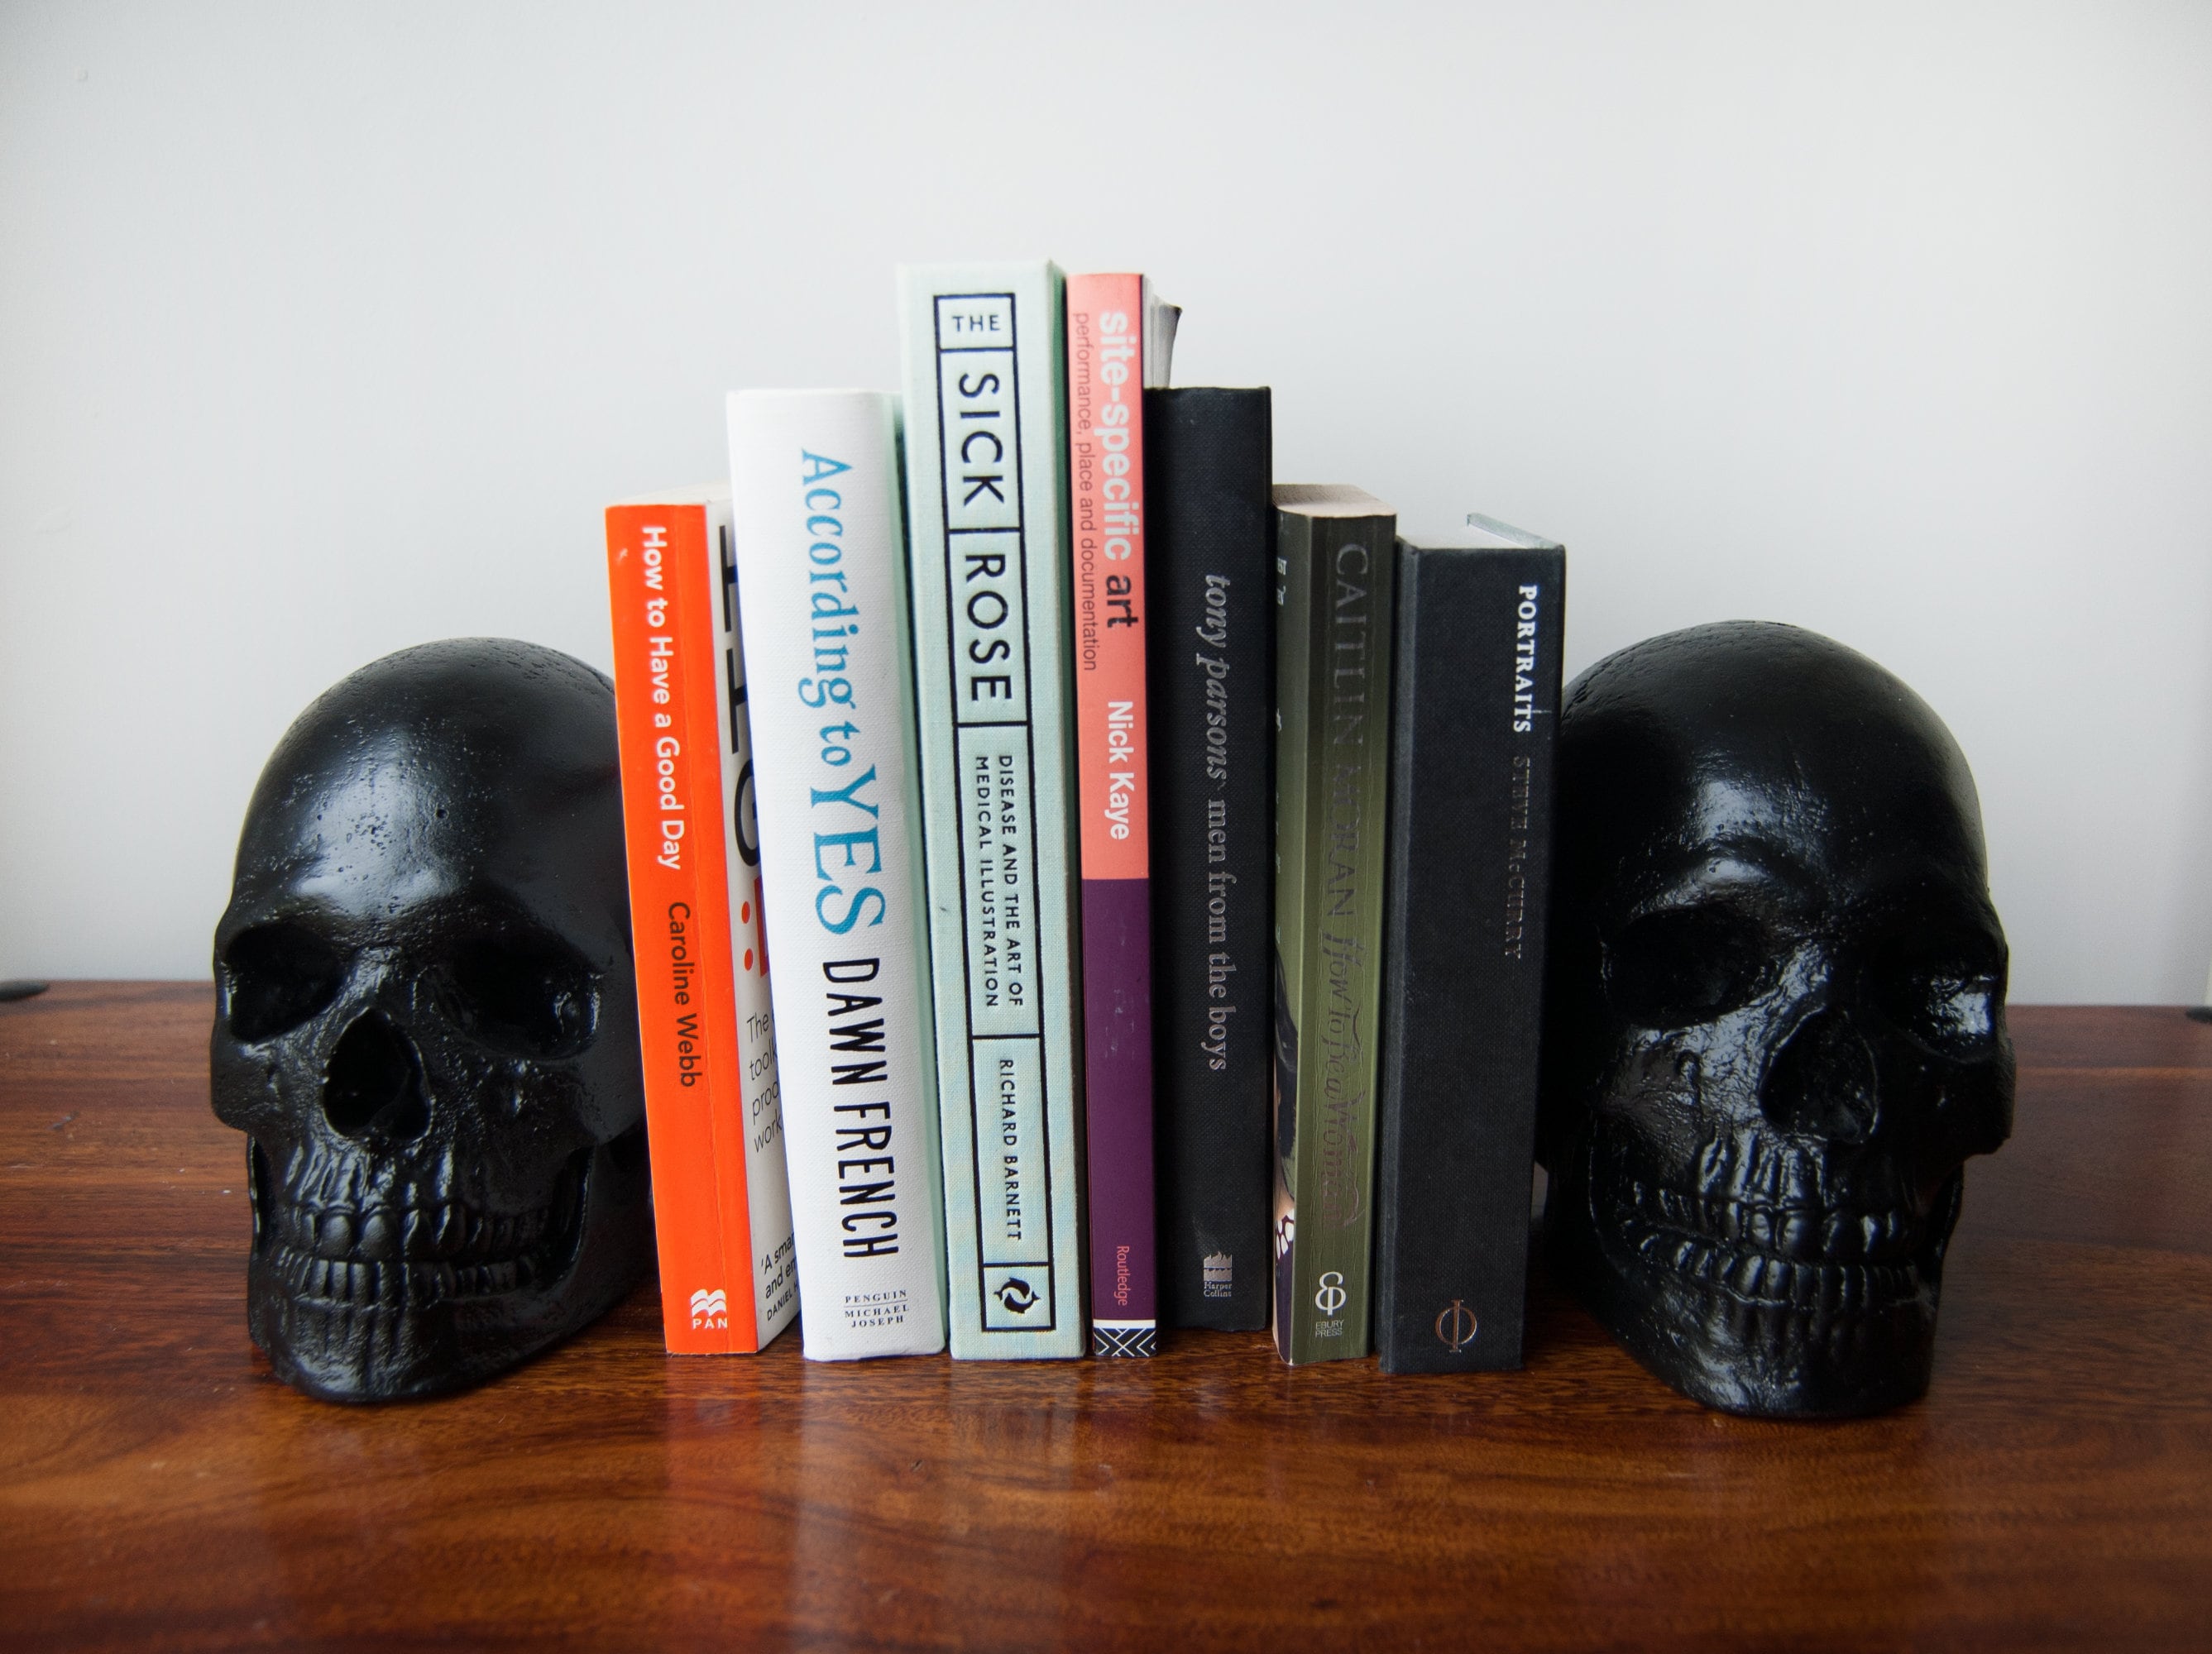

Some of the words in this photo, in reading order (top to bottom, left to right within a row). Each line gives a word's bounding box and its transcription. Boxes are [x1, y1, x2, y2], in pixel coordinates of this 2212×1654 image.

[952, 314, 1001, 332] THE
[1075, 312, 1092, 435] performance,
[959, 373, 1004, 507] SICK
[1075, 442, 1094, 492] place
[1094, 311, 1139, 561] site-specific
[1080, 498, 1098, 531] and
[642, 525, 667, 590] How
[797, 448, 860, 710] According
[646, 598, 668, 628] to
[965, 553, 1013, 702] ROSE
[1081, 538, 1099, 671] documentation
[1105, 573, 1139, 629] art
[1195, 574, 1231, 648] tony
[649, 636, 673, 705] Have
[1333, 543, 1368, 744] CAITLIN
[1514, 584, 1539, 734] PORTRAITS
[654, 713, 672, 728] a
[819, 720, 861, 767] to
[1107, 700, 1135, 763] Nick
[1195, 653, 1231, 784] parsons
[656, 736, 685, 811] Good
[975, 756, 995, 849] MEDICAL
[998, 754, 1017, 836] DISEASE
[1105, 772, 1135, 840] Kaye
[1208, 799, 1227, 863] men
[657, 819, 685, 871] Day
[811, 763, 886, 935] YES
[1003, 844, 1018, 886] AND
[980, 858, 999, 1008] ILLUSTRATION
[1004, 893, 1020, 931] THE
[1208, 871, 1237, 944] from
[668, 901, 691, 1006] Caroline
[1006, 939, 1022, 975] ART
[1209, 951, 1236, 999] the
[822, 957, 888, 1087] DAWN
[1009, 982, 1024, 1007] OF
[677, 1015, 703, 1088] Webb
[746, 1011, 769, 1043] The
[1200, 1006, 1236, 1071] boys
[999, 1059, 1017, 1147] RICHARD
[833, 1102, 899, 1259] FRENCH
[1003, 1155, 1022, 1241] BARNETT
[765, 1265, 783, 1299] and
[767, 1287, 792, 1322] DANIEL
[845, 1289, 907, 1304] PENGUIN
[1113, 1245, 1130, 1306] Routledge
[1204, 1289, 1232, 1298] Collins
[692, 1317, 728, 1330] PAN
[845, 1304, 909, 1317] MICHAEL
[850, 1315, 904, 1328] JOSEPH
[1315, 1319, 1344, 1330] EBURY
[1315, 1327, 1343, 1338] PRESS
